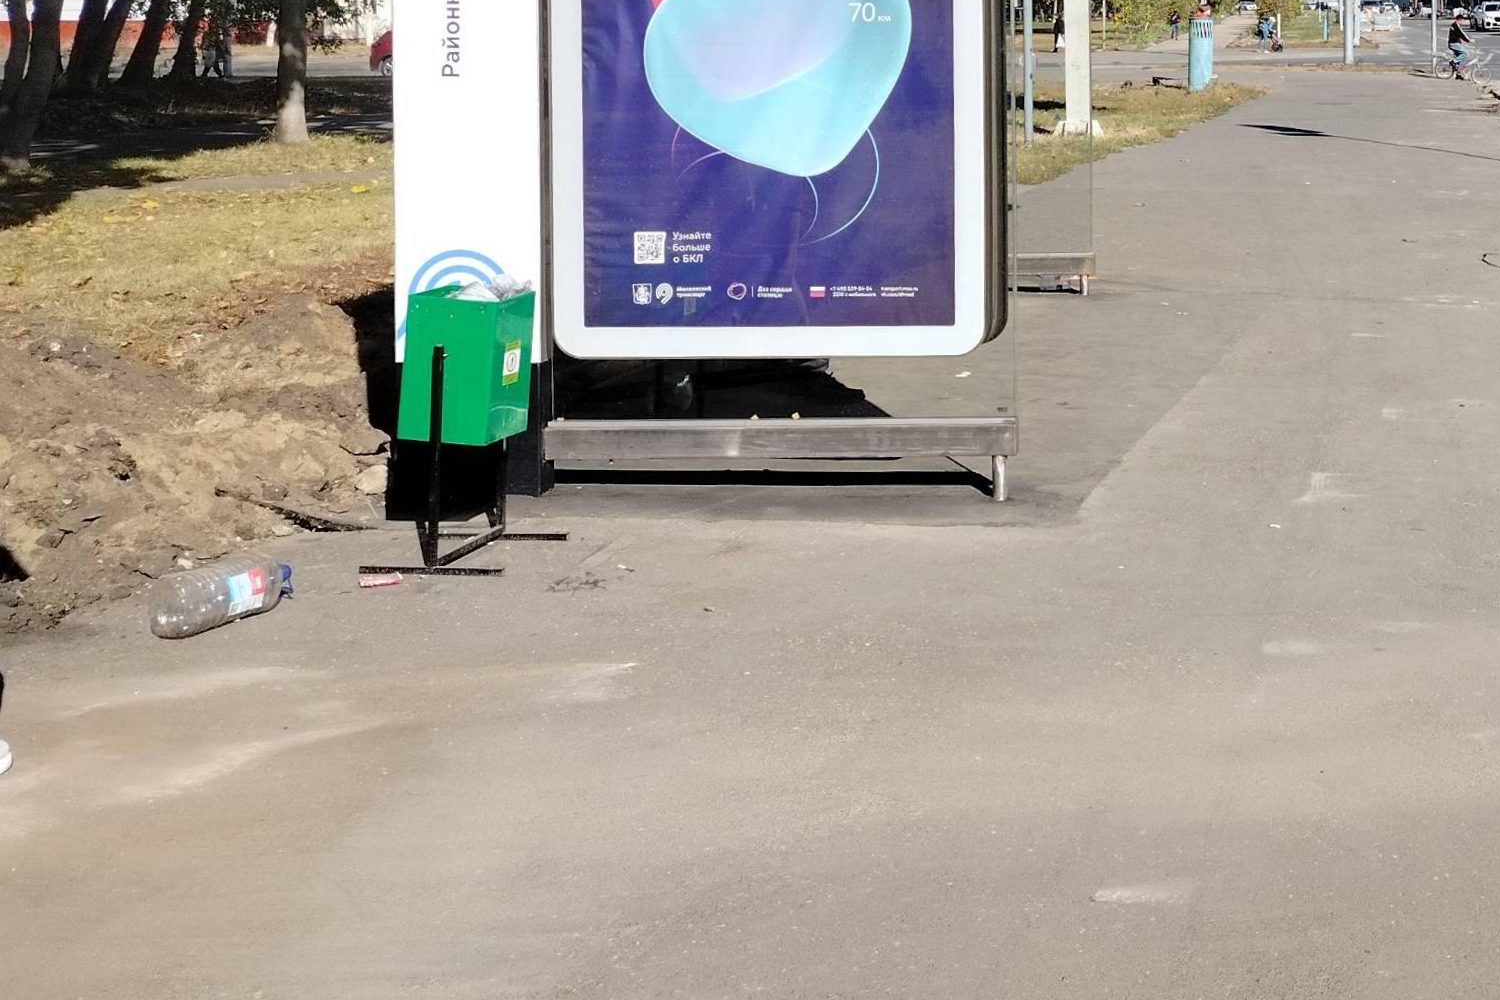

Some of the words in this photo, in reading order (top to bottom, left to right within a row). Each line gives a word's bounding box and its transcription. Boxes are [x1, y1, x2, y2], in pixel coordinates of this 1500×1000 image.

[848, 2, 876, 22] 70
[672, 231, 712, 241] Узнайте
[672, 243, 711, 251] больше
[682, 253, 704, 263] БКЛ
